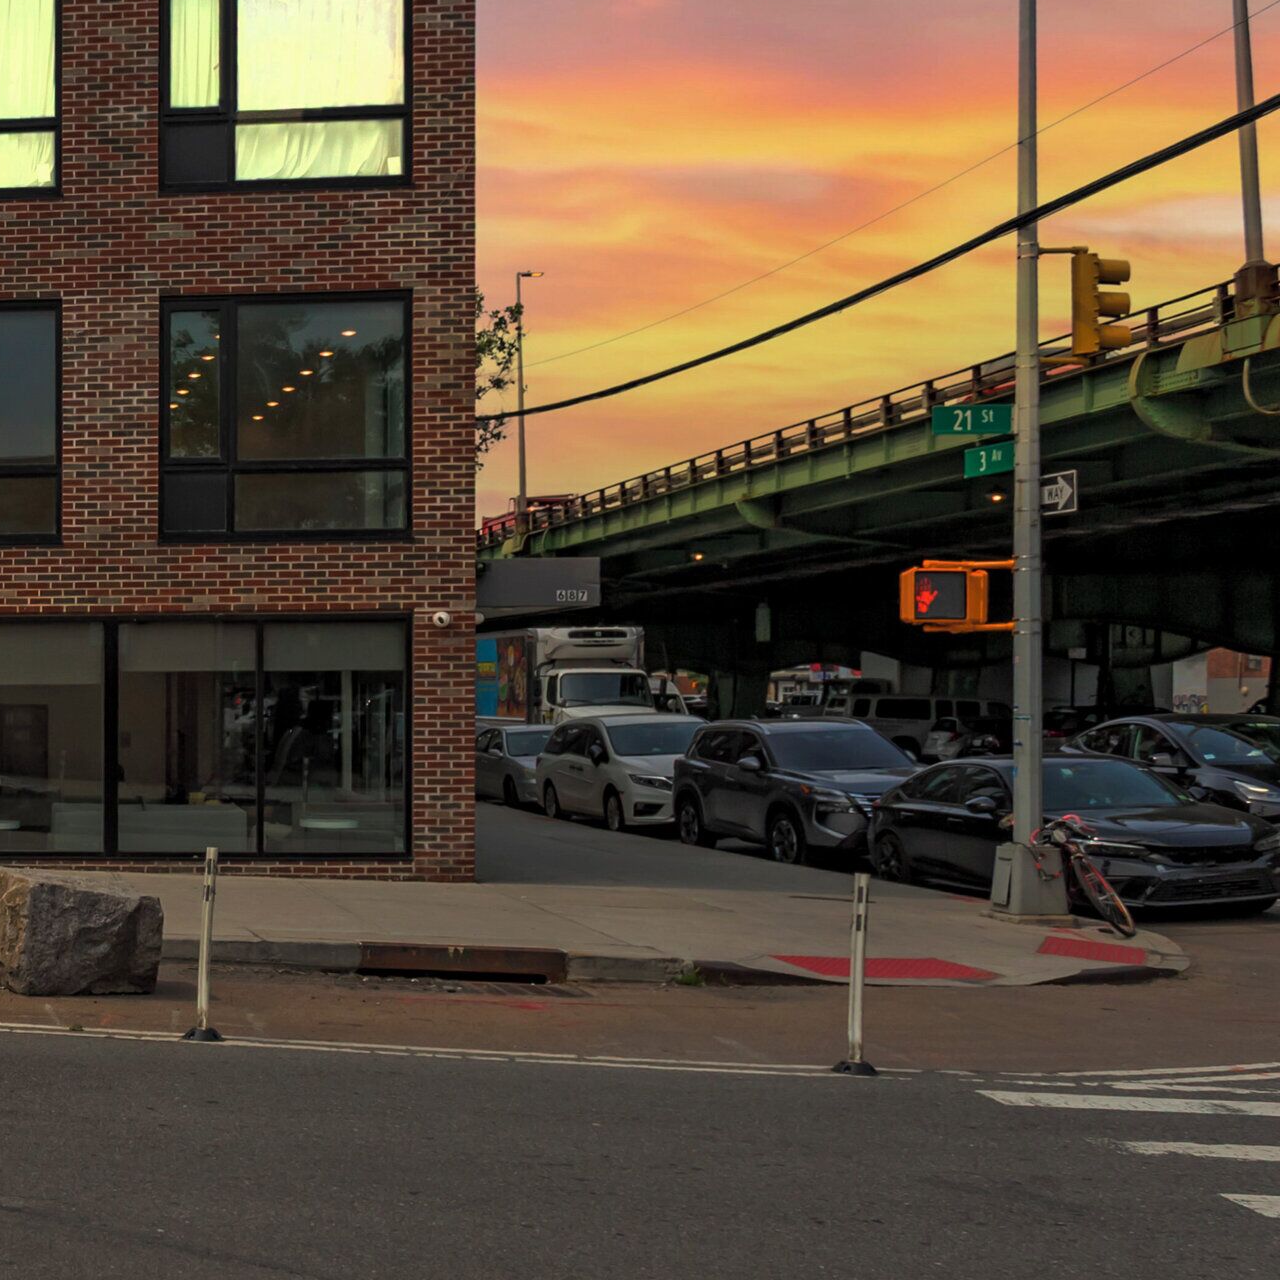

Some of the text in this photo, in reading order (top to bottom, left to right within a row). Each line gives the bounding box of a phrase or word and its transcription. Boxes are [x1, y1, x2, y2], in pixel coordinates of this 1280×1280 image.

[953, 409, 994, 431] 21 St
[979, 449, 1002, 471] 3 Av
[1046, 486, 1064, 501] WAY
[557, 590, 587, 601] 687
